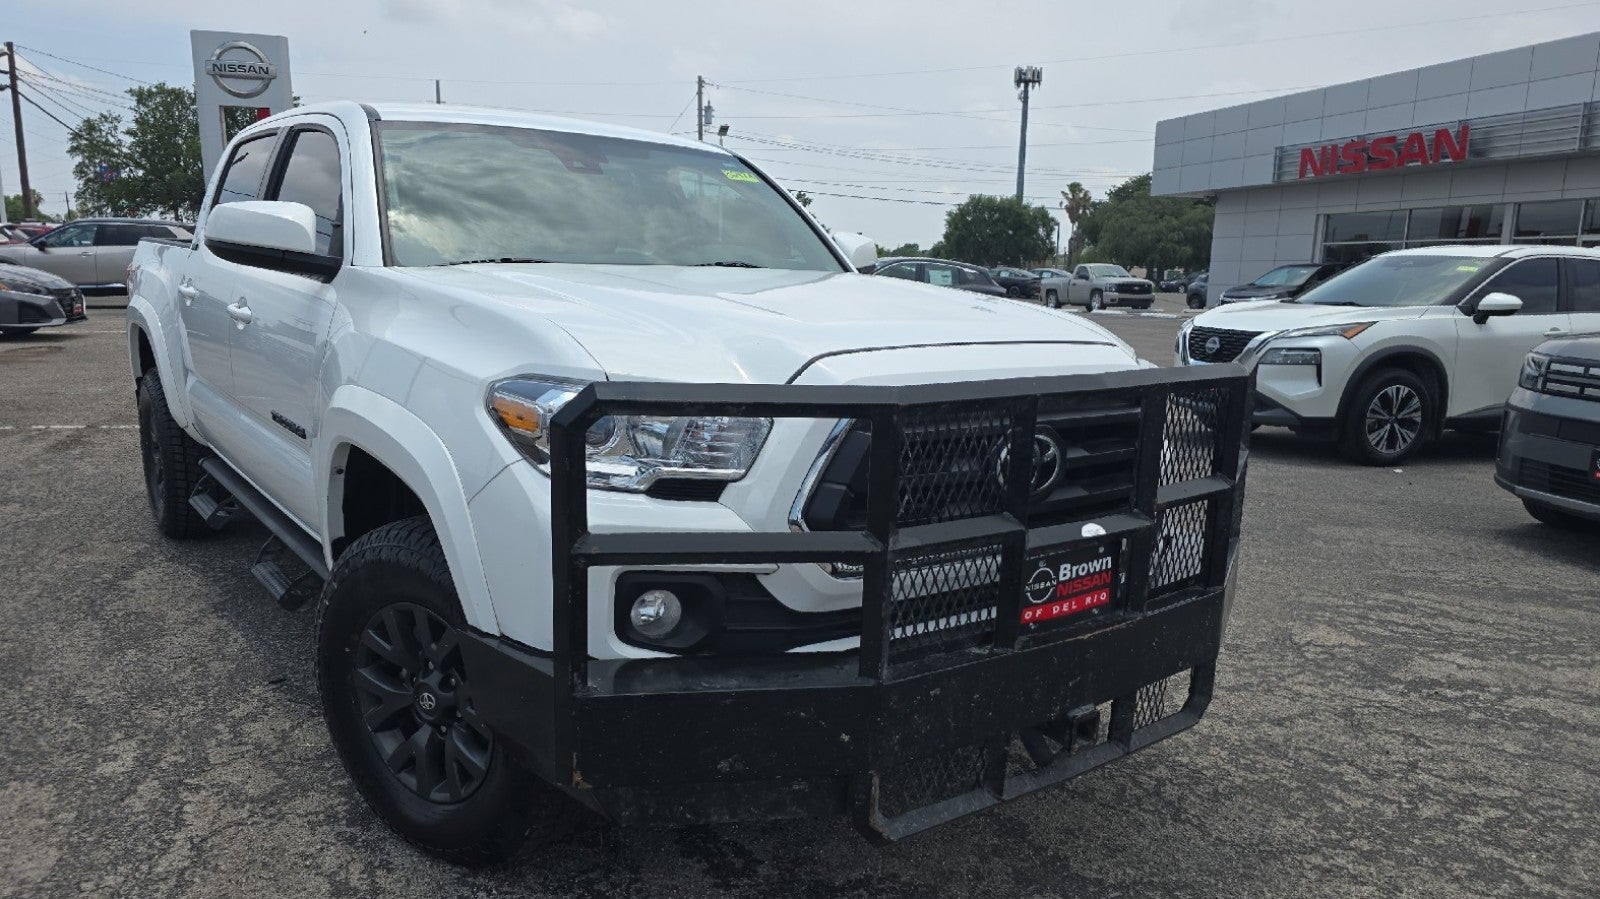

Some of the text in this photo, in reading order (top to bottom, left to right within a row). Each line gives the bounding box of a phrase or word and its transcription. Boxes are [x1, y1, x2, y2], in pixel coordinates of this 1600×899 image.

[212, 63, 269, 75] NISSAN
[1299, 123, 1470, 179] NISSAN
[1059, 556, 1112, 581] Brown
[1025, 579, 1057, 592] NISSAN
[1057, 571, 1111, 597] NISSAN
[1024, 592, 1107, 620] OF DEL RIO
